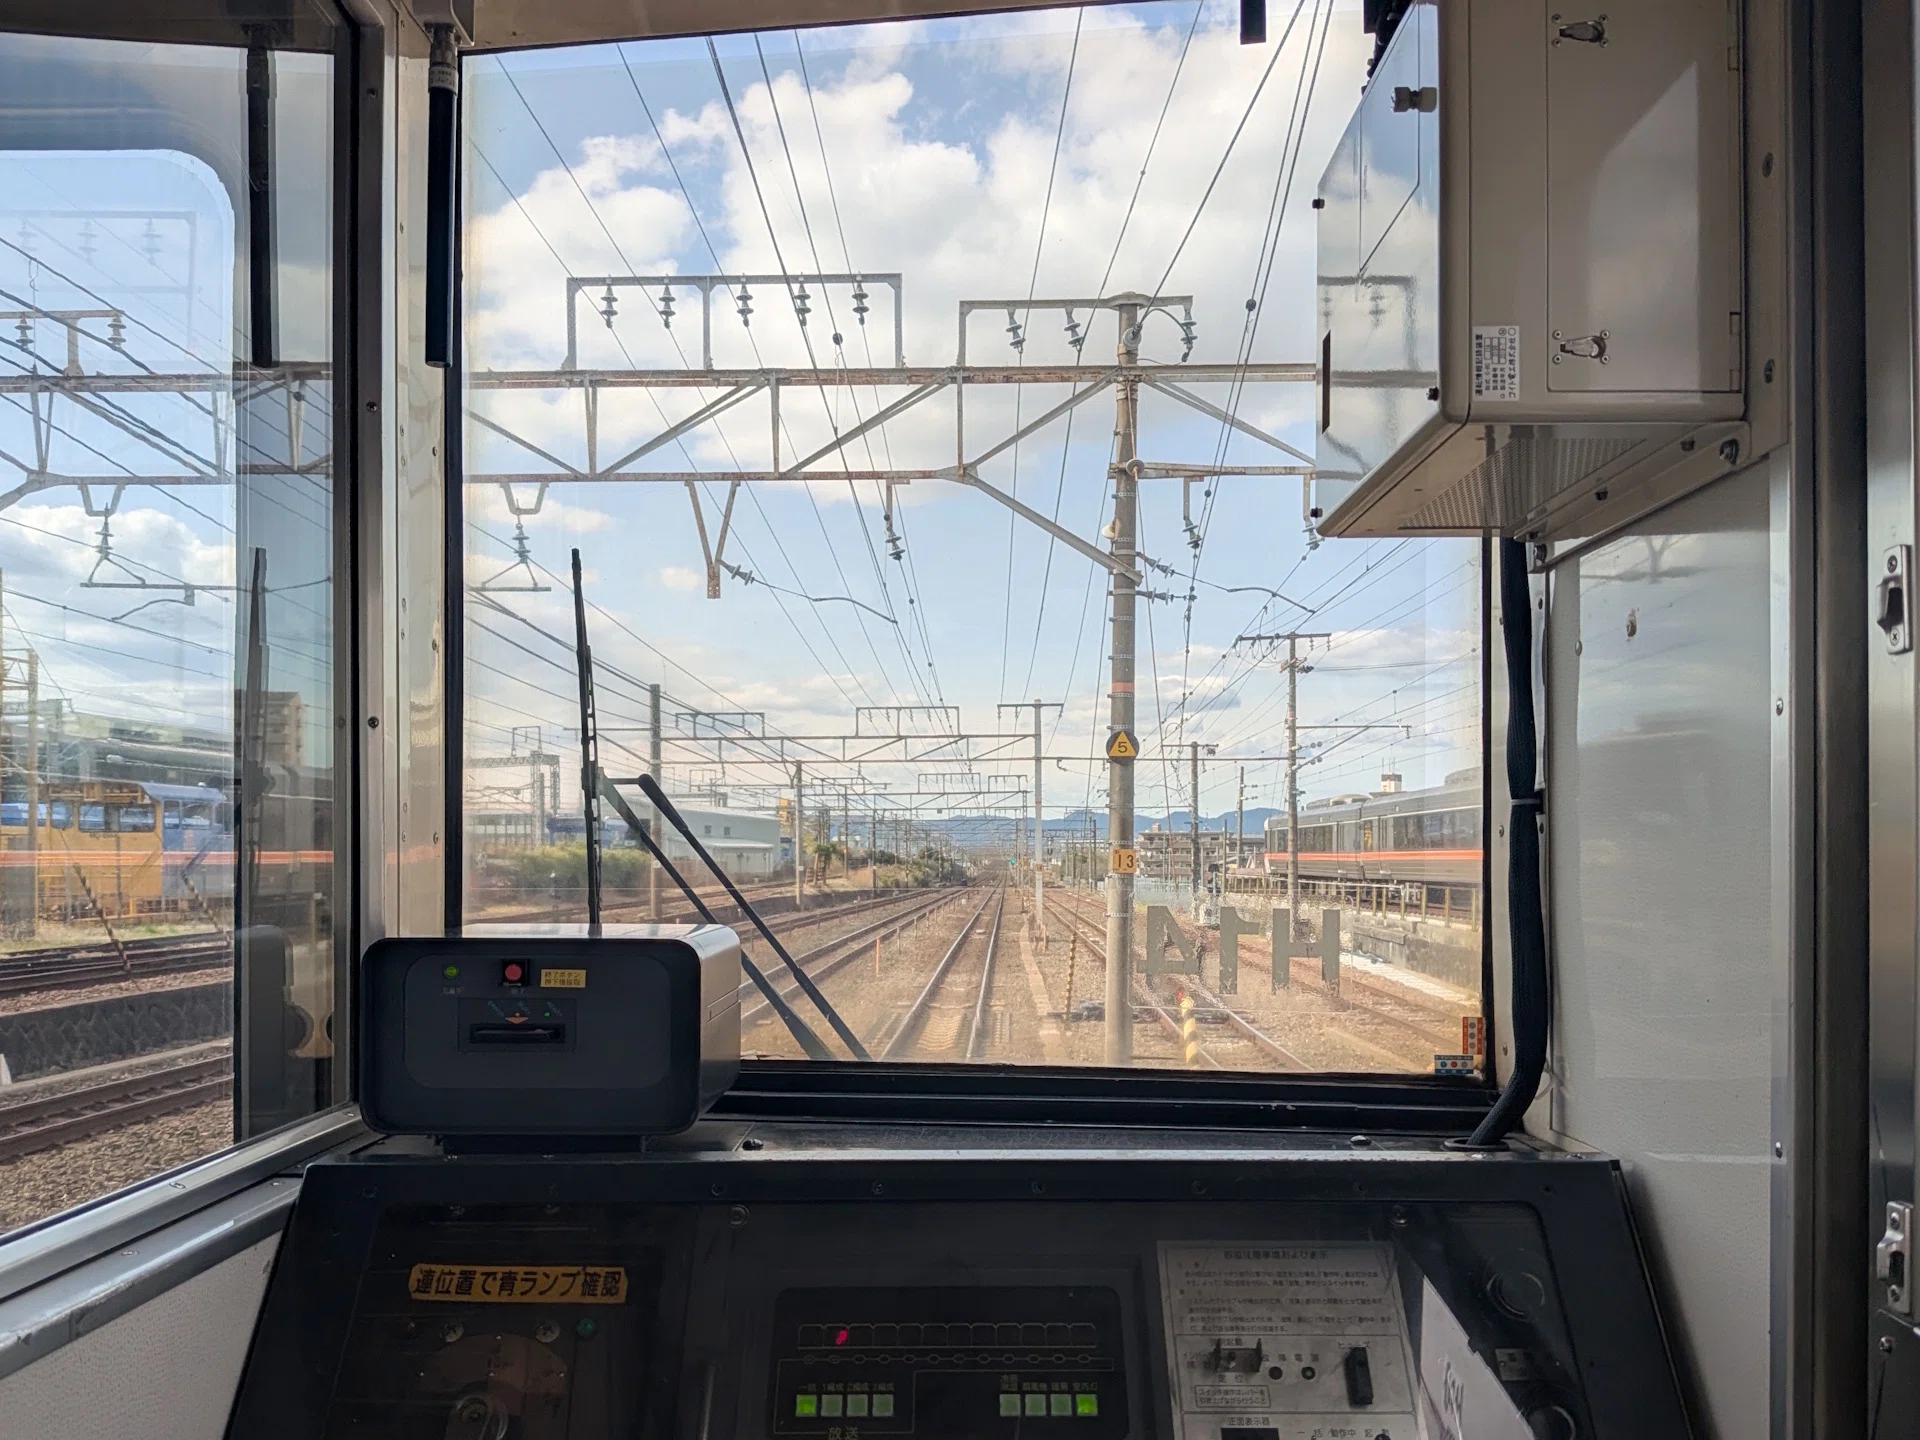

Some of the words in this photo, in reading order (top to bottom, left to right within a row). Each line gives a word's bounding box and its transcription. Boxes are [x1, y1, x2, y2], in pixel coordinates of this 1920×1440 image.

[1508, 337, 1516, 398] コイト電工株式会社
[1117, 742, 1128, 753] 5
[1118, 854, 1134, 868] 13
[1227, 1416, 1270, 1426] 正面表示器
[827, 1426, 860, 1440] 放送
[1330, 1428, 1356, 1438] 動作中
